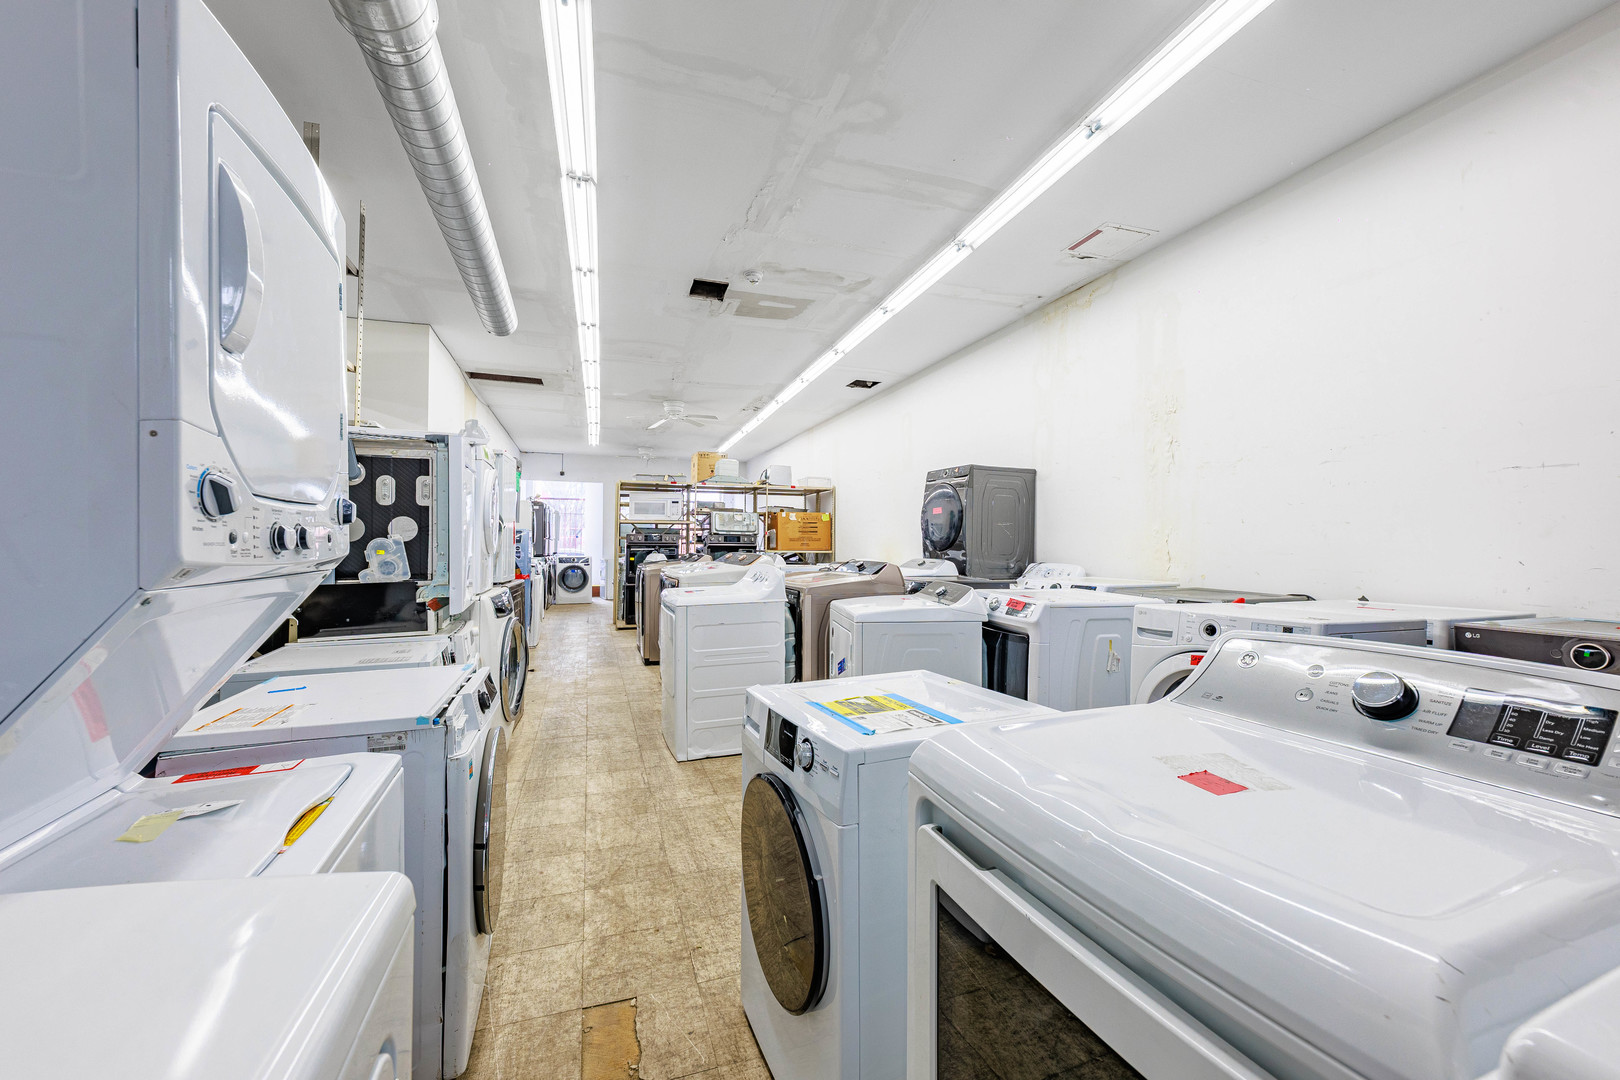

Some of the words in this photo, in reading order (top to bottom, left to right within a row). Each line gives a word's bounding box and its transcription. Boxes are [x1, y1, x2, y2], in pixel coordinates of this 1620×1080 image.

[1497, 735, 1514, 743] Time
[1531, 743, 1551, 751] Level
[1569, 751, 1590, 760] Temp
